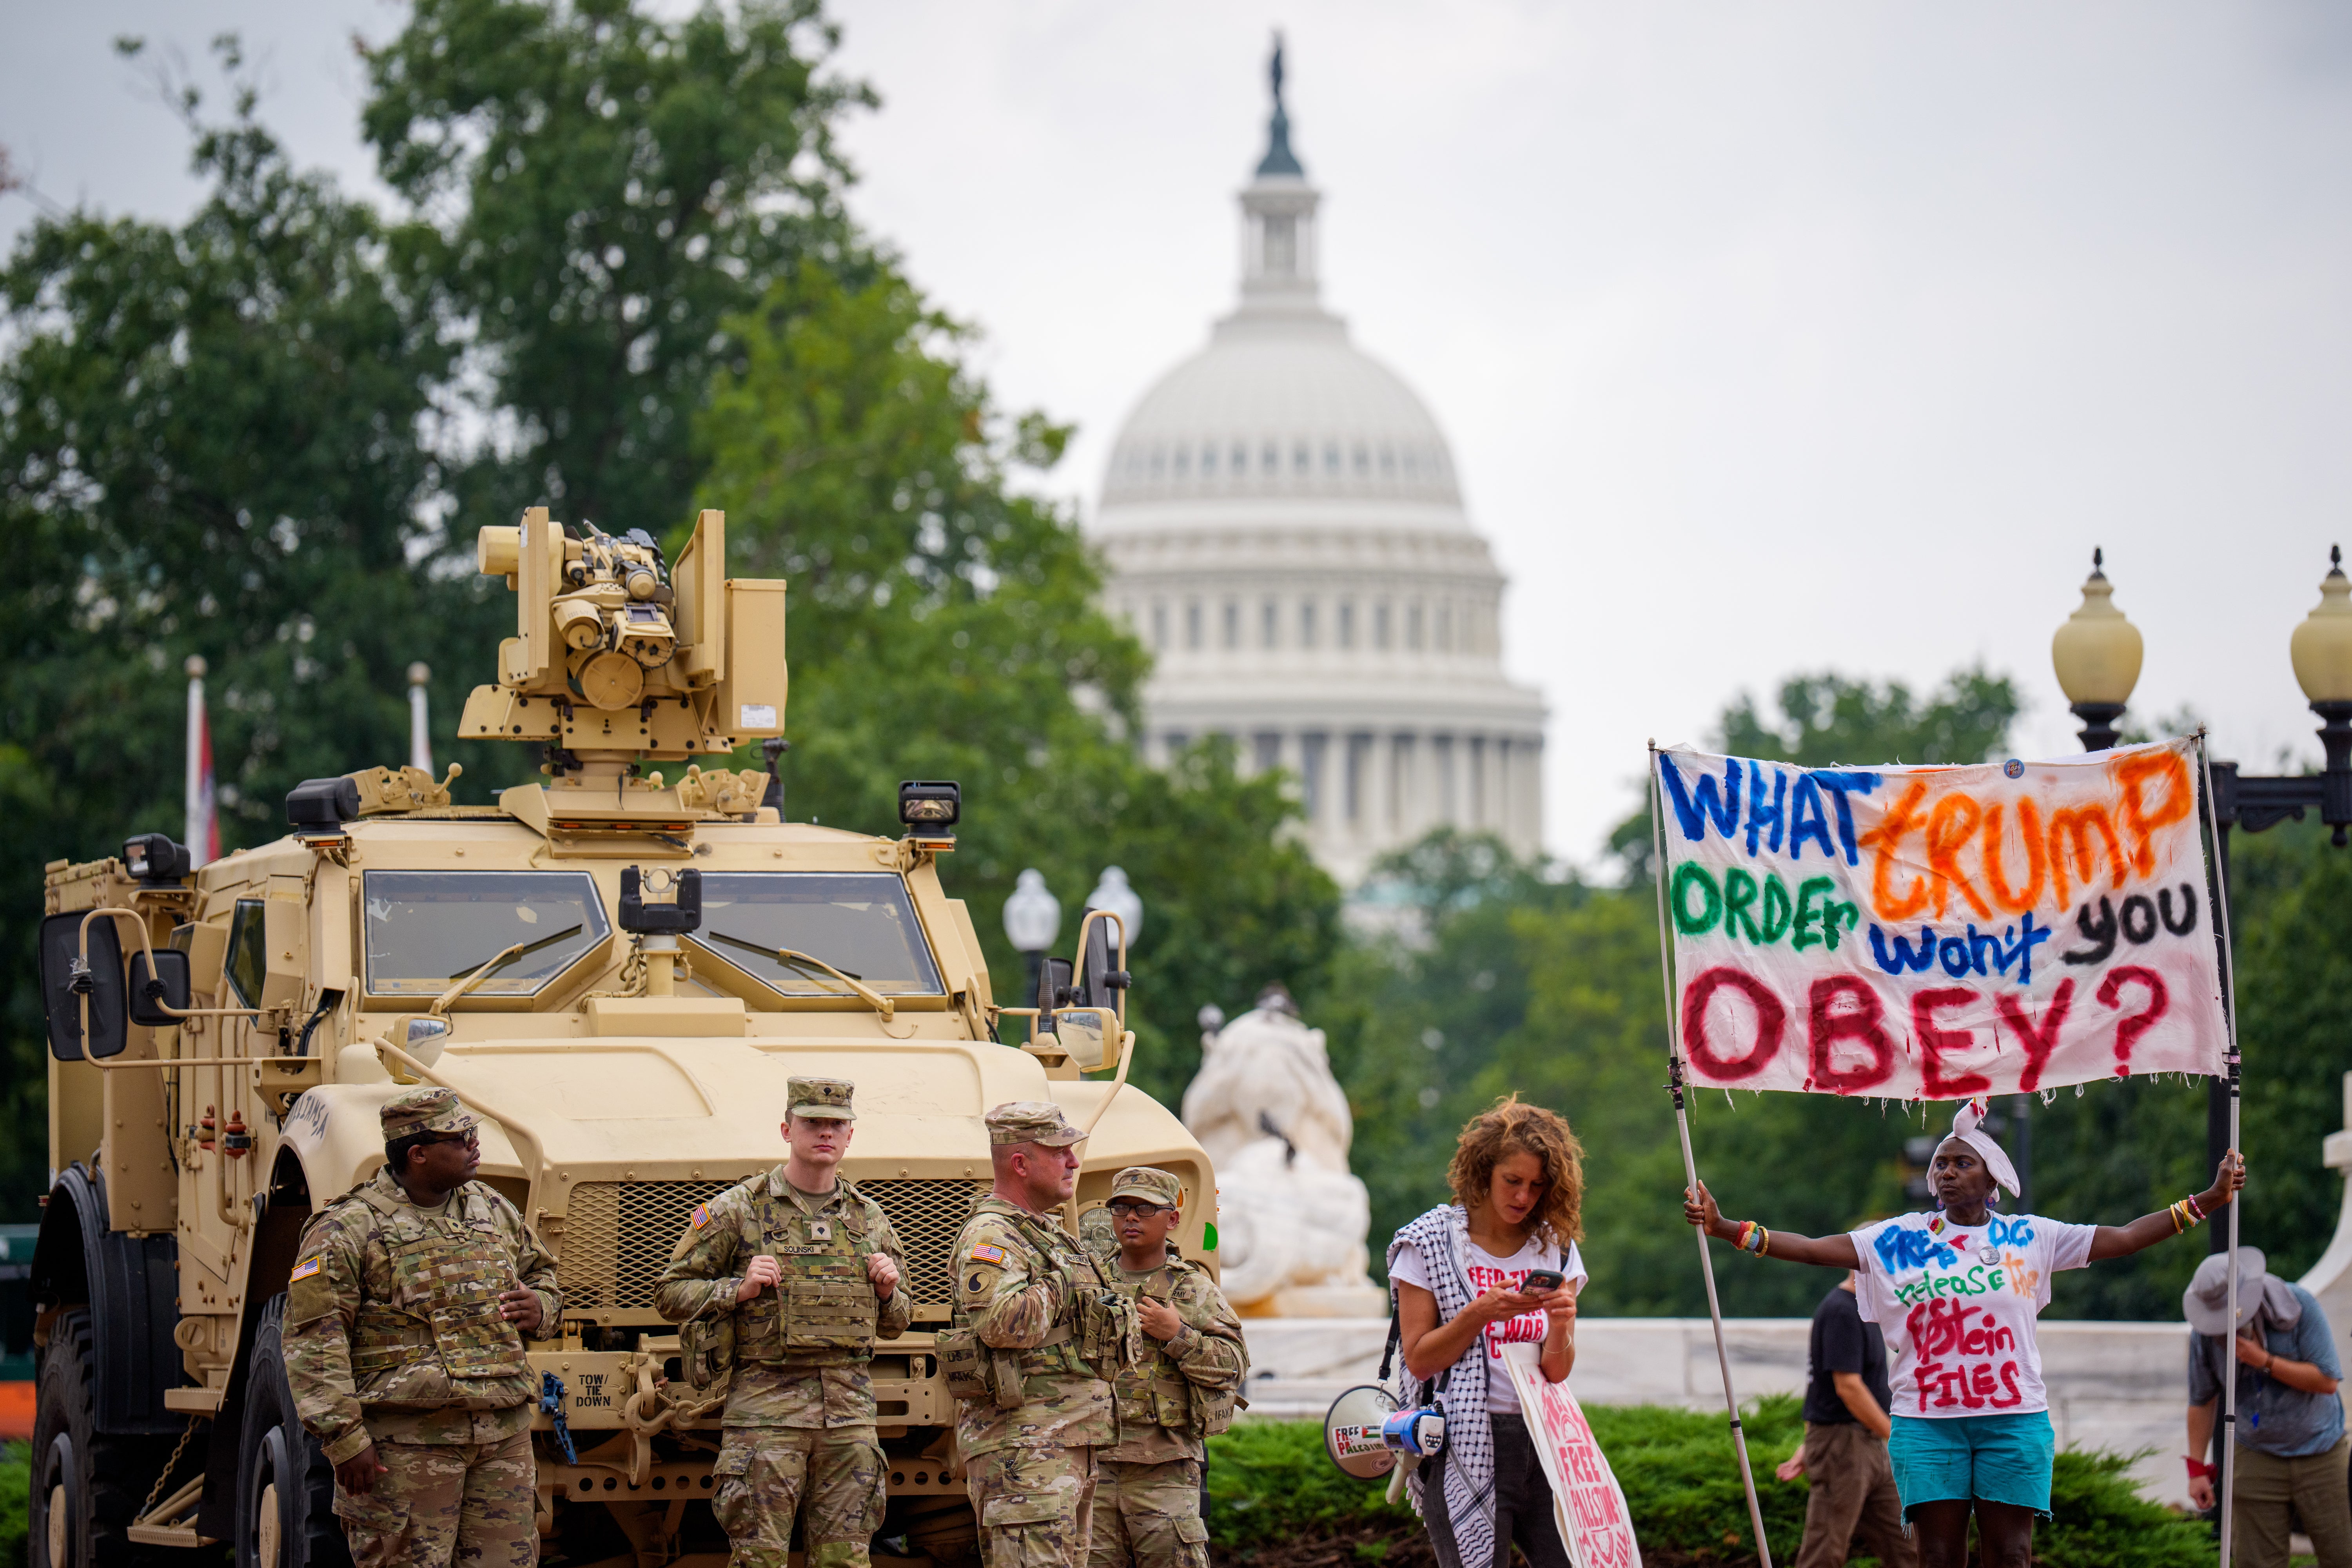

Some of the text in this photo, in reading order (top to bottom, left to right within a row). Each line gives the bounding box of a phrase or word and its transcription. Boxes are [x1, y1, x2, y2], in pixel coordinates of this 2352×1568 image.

[1659, 753, 1883, 866] WHAT
[1468, 1266, 1505, 1288] FEED
[1504, 1318, 1543, 1341] WAR
[947, 1351, 962, 1362] US
[579, 1374, 608, 1385] TOW/
[1914, 1361, 2022, 1413] FILES
[586, 1385, 602, 1396] TIE
[577, 1396, 610, 1407] DOWN
[1215, 1408, 1229, 1421] IFAK
[1335, 1426, 1359, 1442] FREE
[1558, 1446, 1601, 1486] FREE
[1570, 1485, 1620, 1528] PALESTINE
